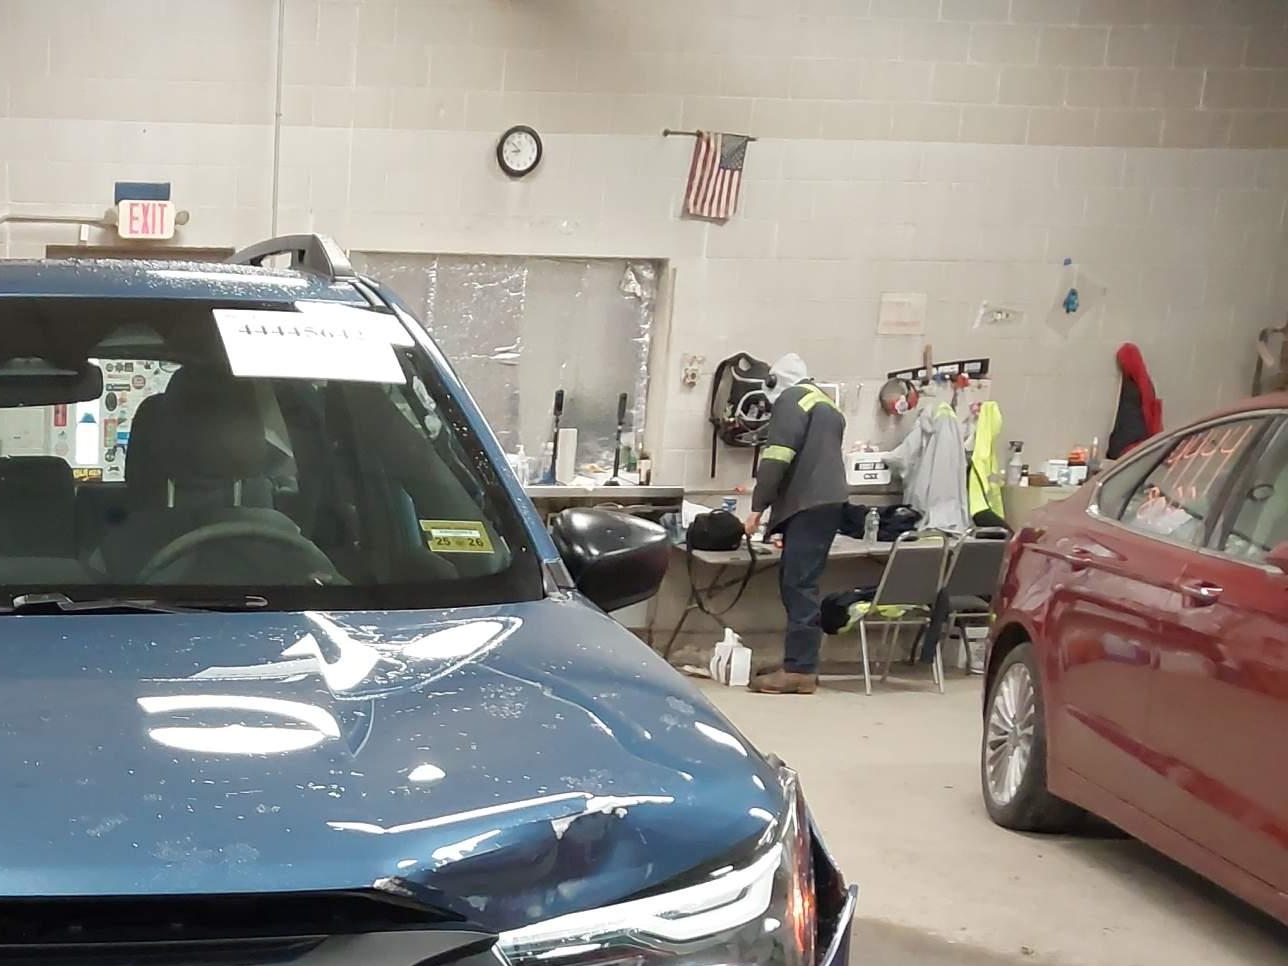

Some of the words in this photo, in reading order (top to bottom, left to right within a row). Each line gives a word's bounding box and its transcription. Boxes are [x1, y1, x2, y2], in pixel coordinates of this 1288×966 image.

[129, 203, 168, 235] EXIT
[435, 537, 451, 546] 25
[468, 538, 484, 547] 26
